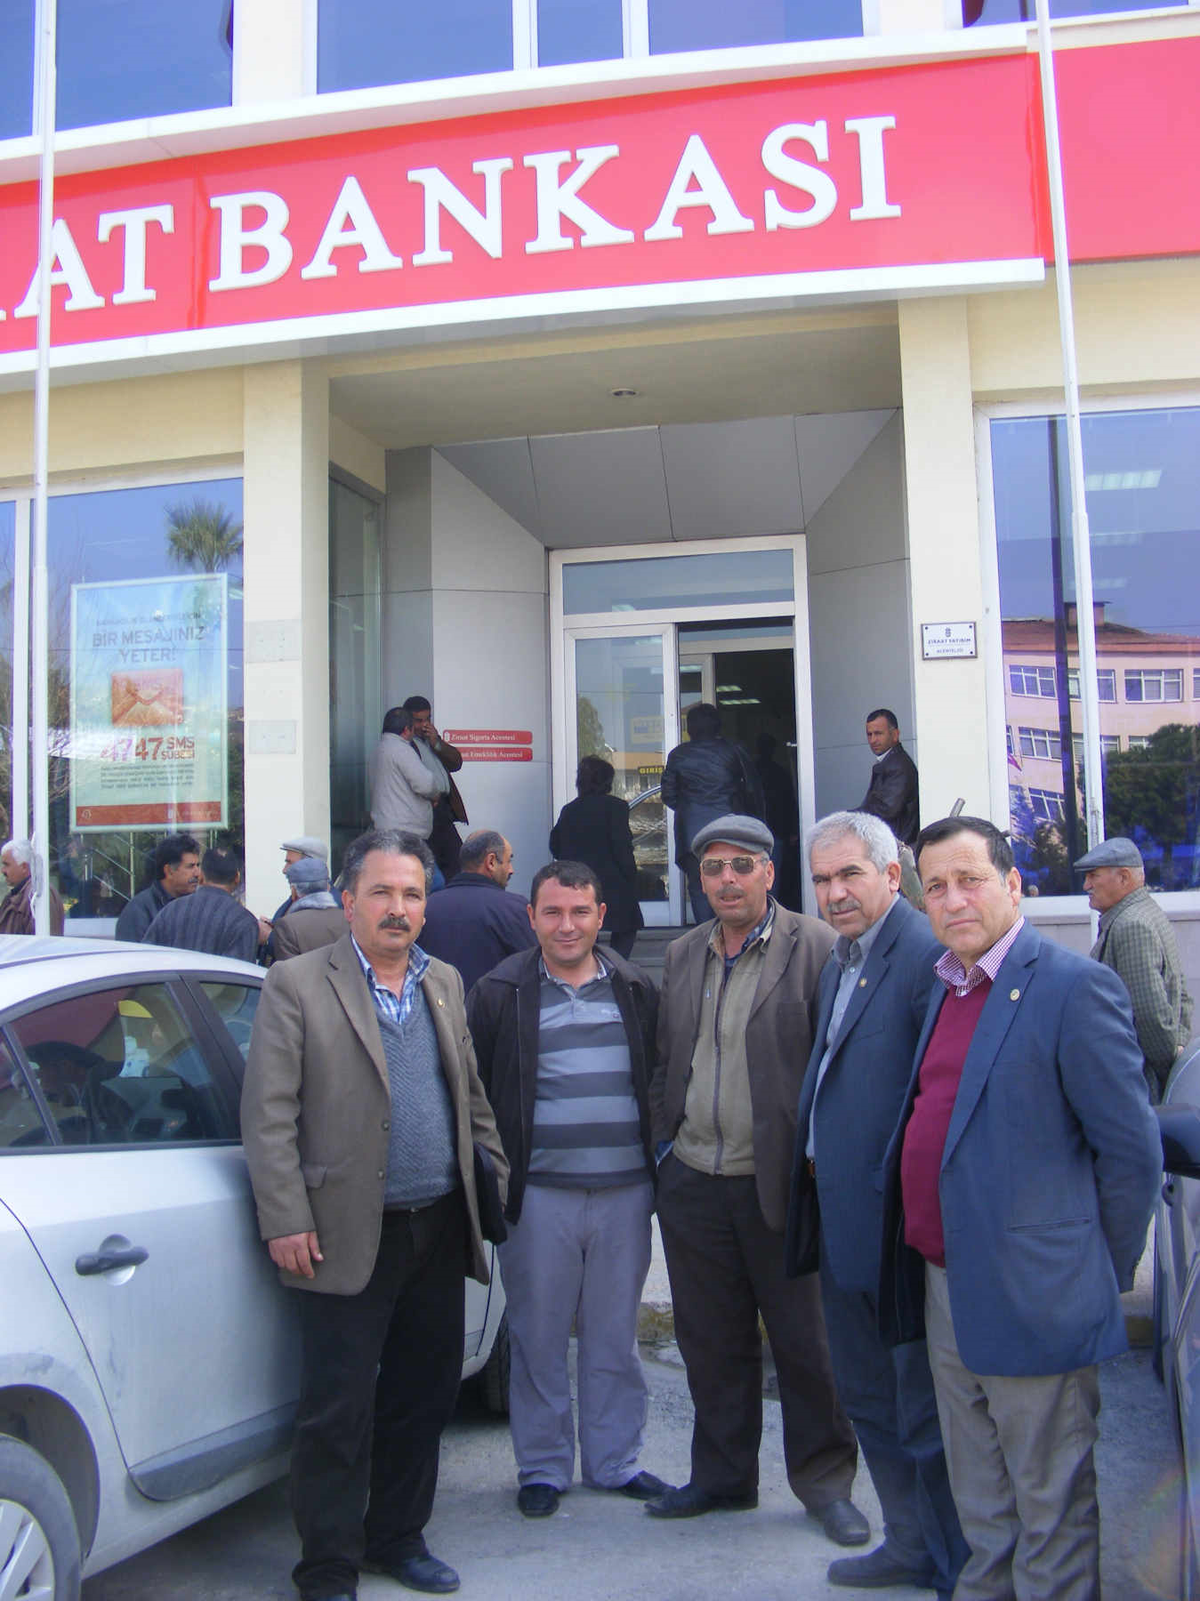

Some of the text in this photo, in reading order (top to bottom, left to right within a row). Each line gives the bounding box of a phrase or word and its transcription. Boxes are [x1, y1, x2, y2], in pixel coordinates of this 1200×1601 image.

[0, 115, 901, 321] AT BANKASI
[166, 735, 195, 750] SMS
